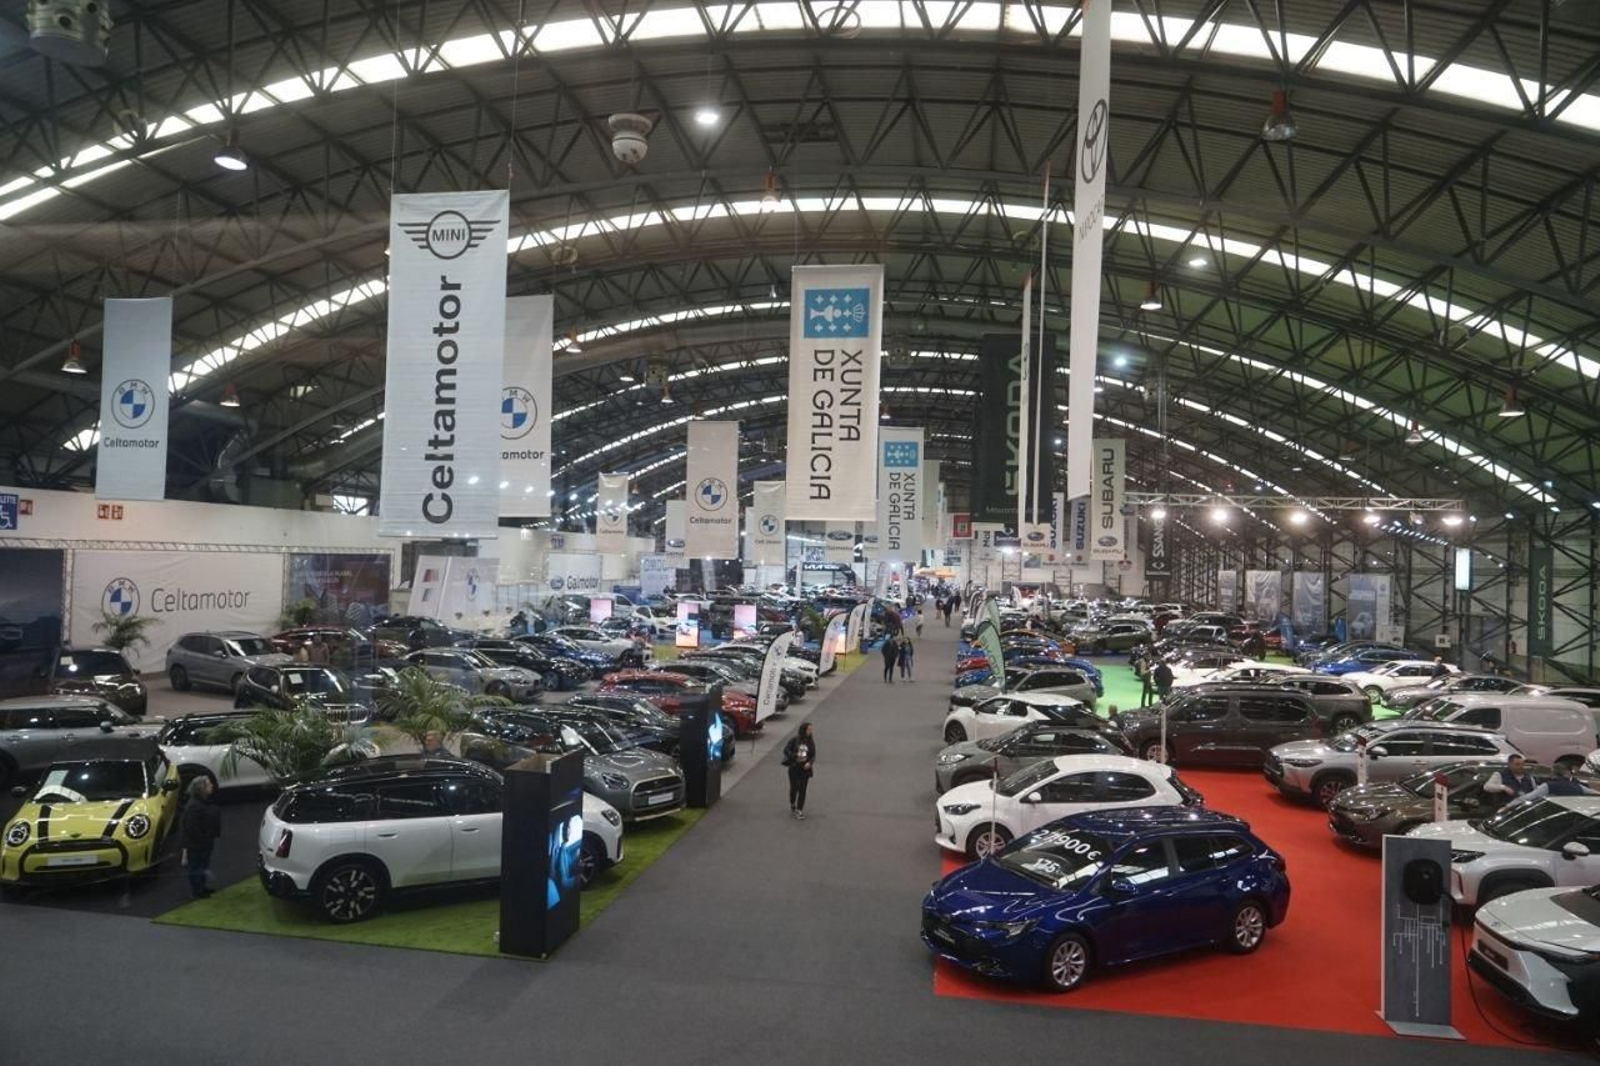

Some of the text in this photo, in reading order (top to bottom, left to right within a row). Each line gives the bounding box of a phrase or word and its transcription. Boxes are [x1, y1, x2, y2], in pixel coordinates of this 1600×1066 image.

[432, 228, 466, 242] MINI
[422, 274, 462, 525] Celtamotor
[839, 349, 862, 442] XUNTA
[104, 436, 160, 448] Celtamotor
[810, 349, 835, 500] DE GALICIA
[500, 450, 545, 460] amotor
[888, 472, 901, 551] DE GALICIA
[903, 472, 915, 521] XUNTA
[1102, 448, 1115, 530] SUBARU
[1075, 501, 1087, 551] SUZUKI
[151, 587, 251, 613] Celtamotor
